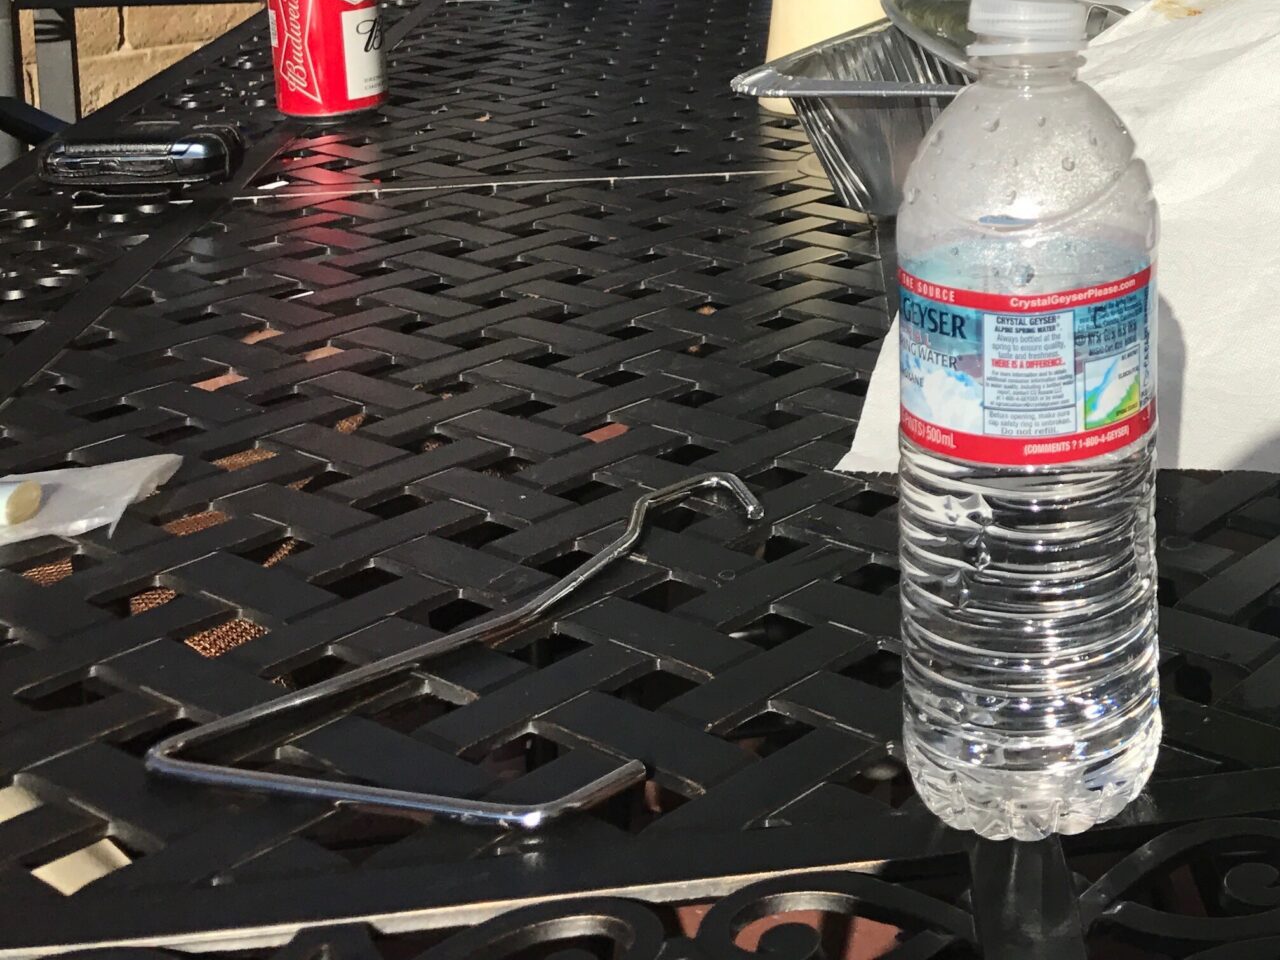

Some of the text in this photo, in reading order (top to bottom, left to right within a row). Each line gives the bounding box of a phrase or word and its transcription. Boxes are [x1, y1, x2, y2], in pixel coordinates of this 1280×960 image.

[917, 281, 956, 303] SOURCE
[1009, 277, 1136, 310] CrystalGeyserPlease.com
[903, 296, 967, 339] GEYSER
[996, 316, 1027, 325] CRYSTAL
[997, 335, 1018, 343] Always
[991, 358, 1010, 368] THERE
[1011, 360, 1018, 368] IS
[1019, 360, 1025, 368] A
[926, 425, 957, 449] 500mL
[1024, 424, 1130, 456] (COMMENTS ? 1-800-4-GEYSER)
